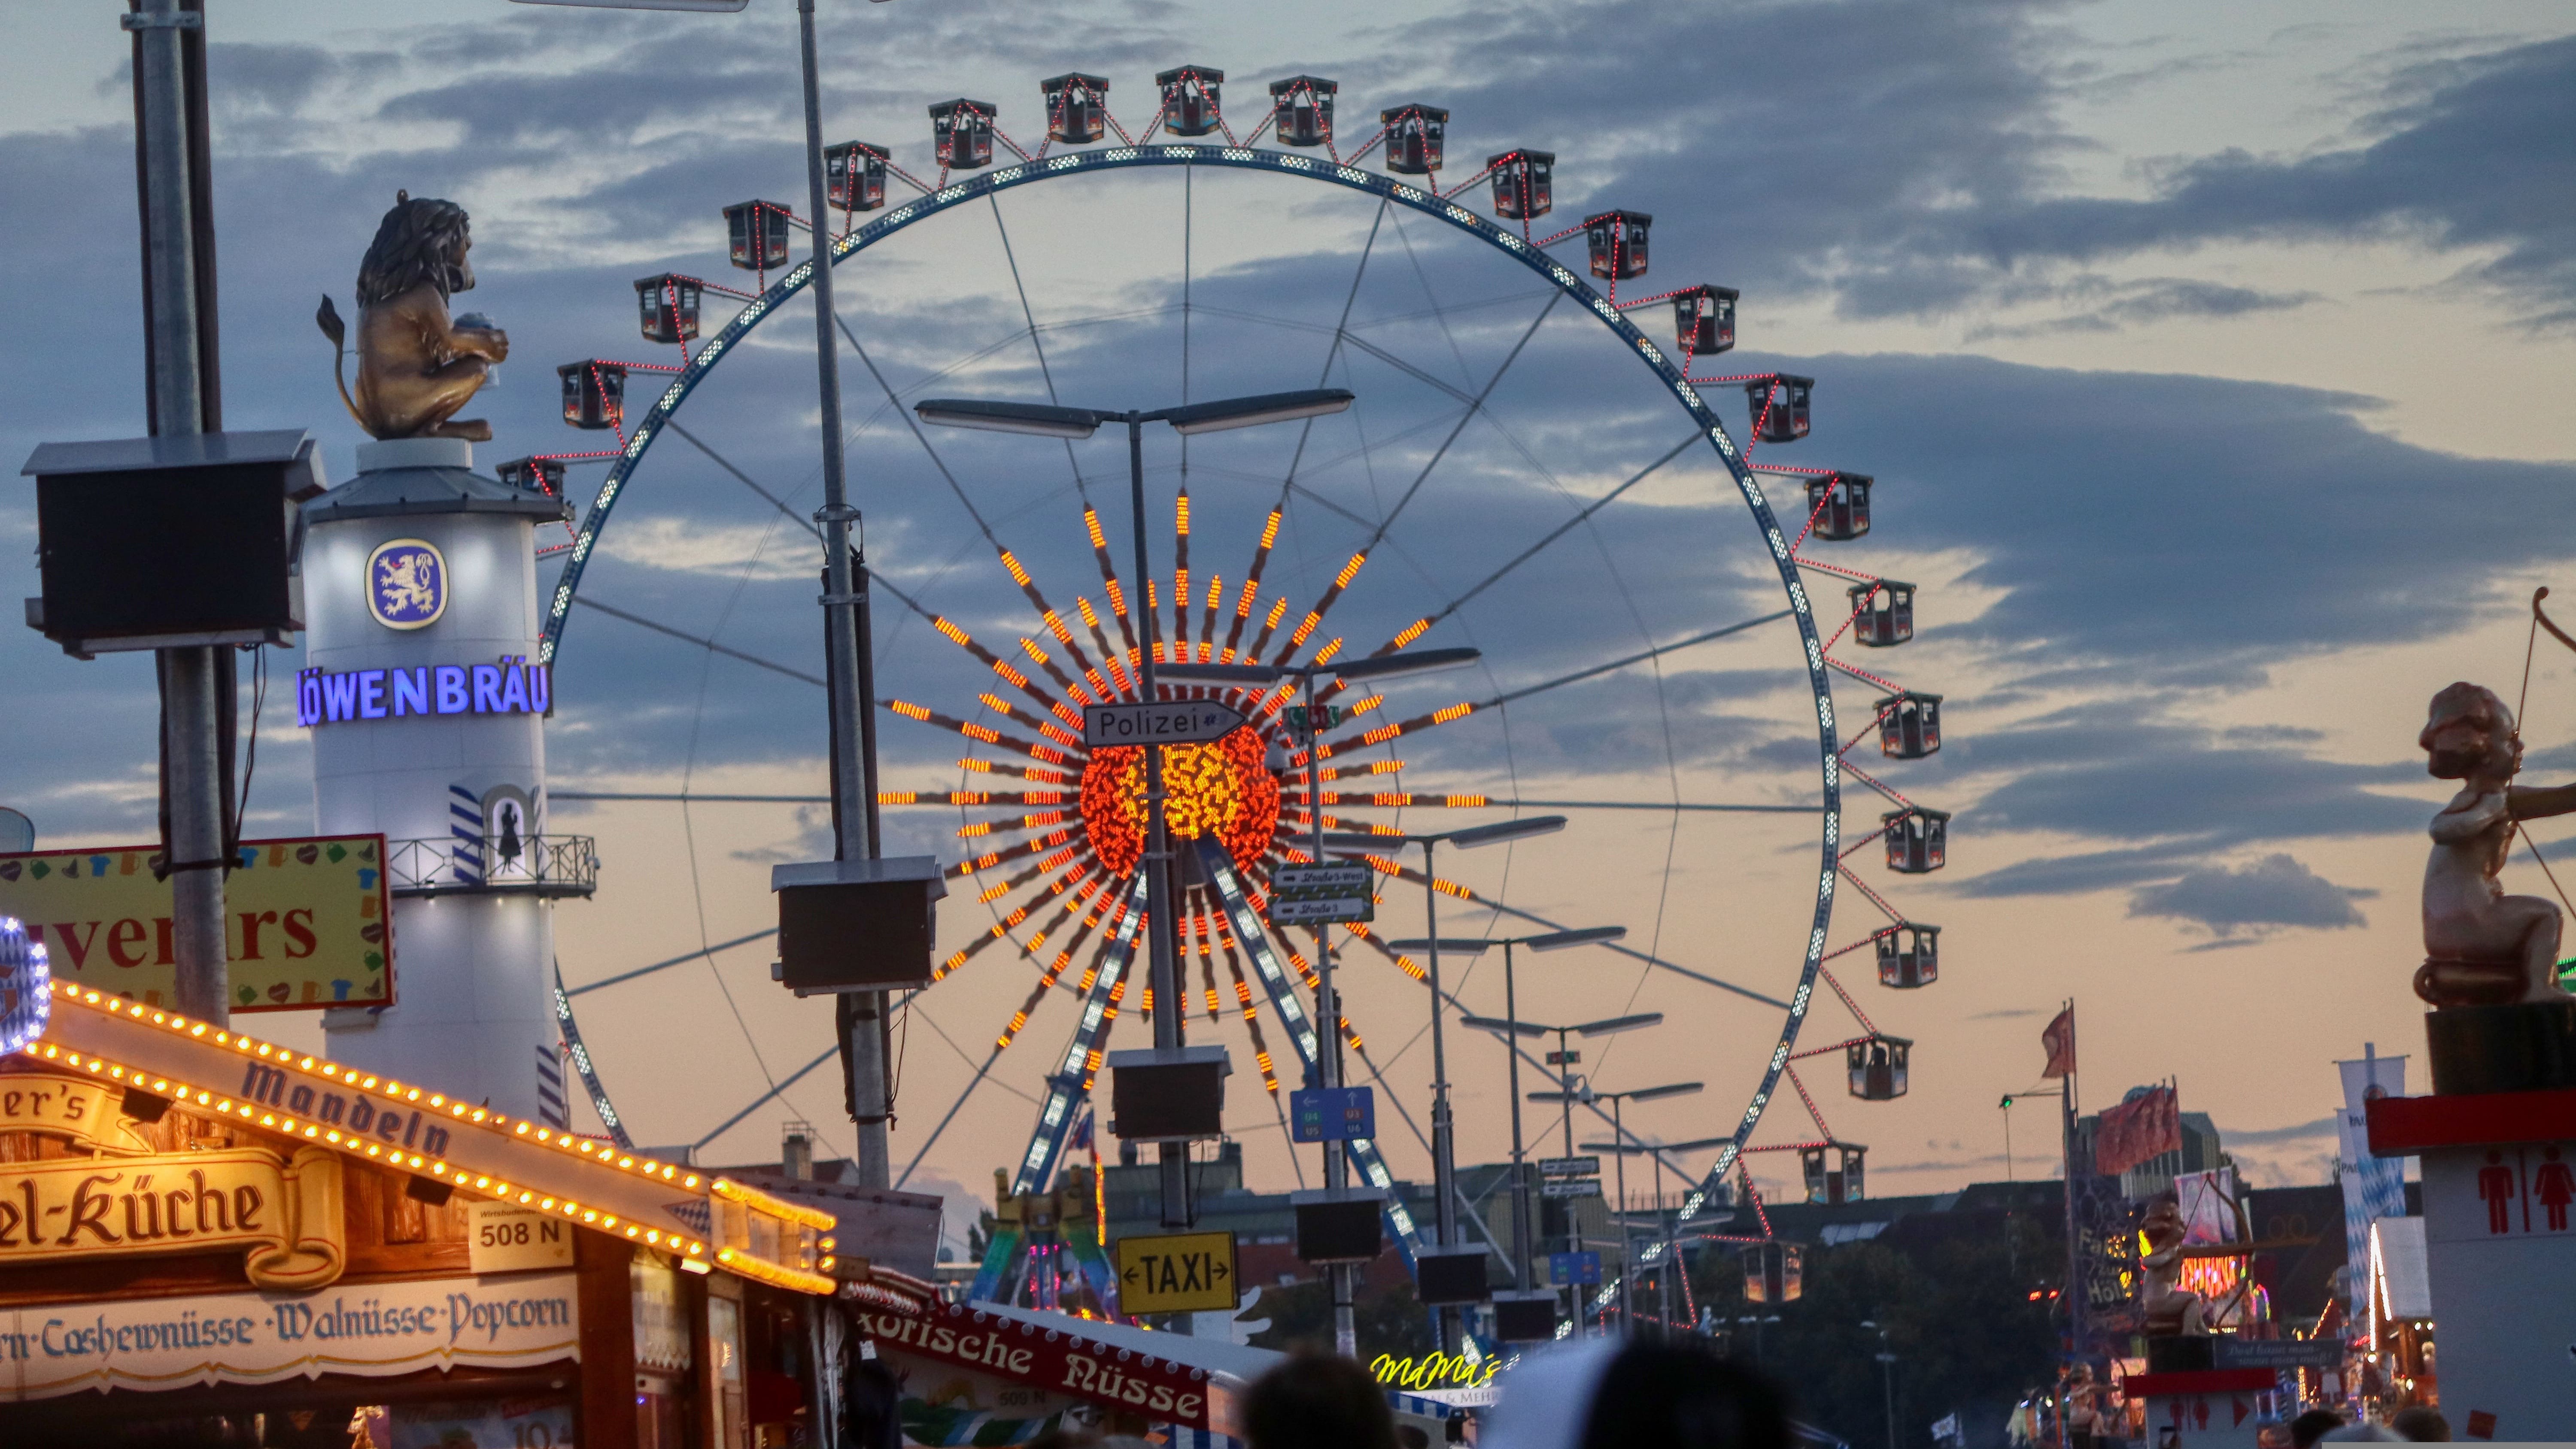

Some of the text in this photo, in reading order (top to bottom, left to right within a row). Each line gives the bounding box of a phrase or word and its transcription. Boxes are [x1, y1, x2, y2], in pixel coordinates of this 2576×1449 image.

[296, 655, 547, 727] LÖWENBRÄU
[1100, 708, 1197, 737] Polizei
[241, 1060, 450, 1158] Mandeln
[0, 1168, 261, 1246] el-Küche
[480, 1219, 559, 1247] 508 N
[1140, 1252, 1213, 1294] TAXI
[42, 1311, 255, 1362] Cashewnüsse
[273, 1297, 437, 1342] Walnüsse
[446, 1291, 569, 1345] Popcorn
[1062, 1352, 1203, 1419] Nüsse
